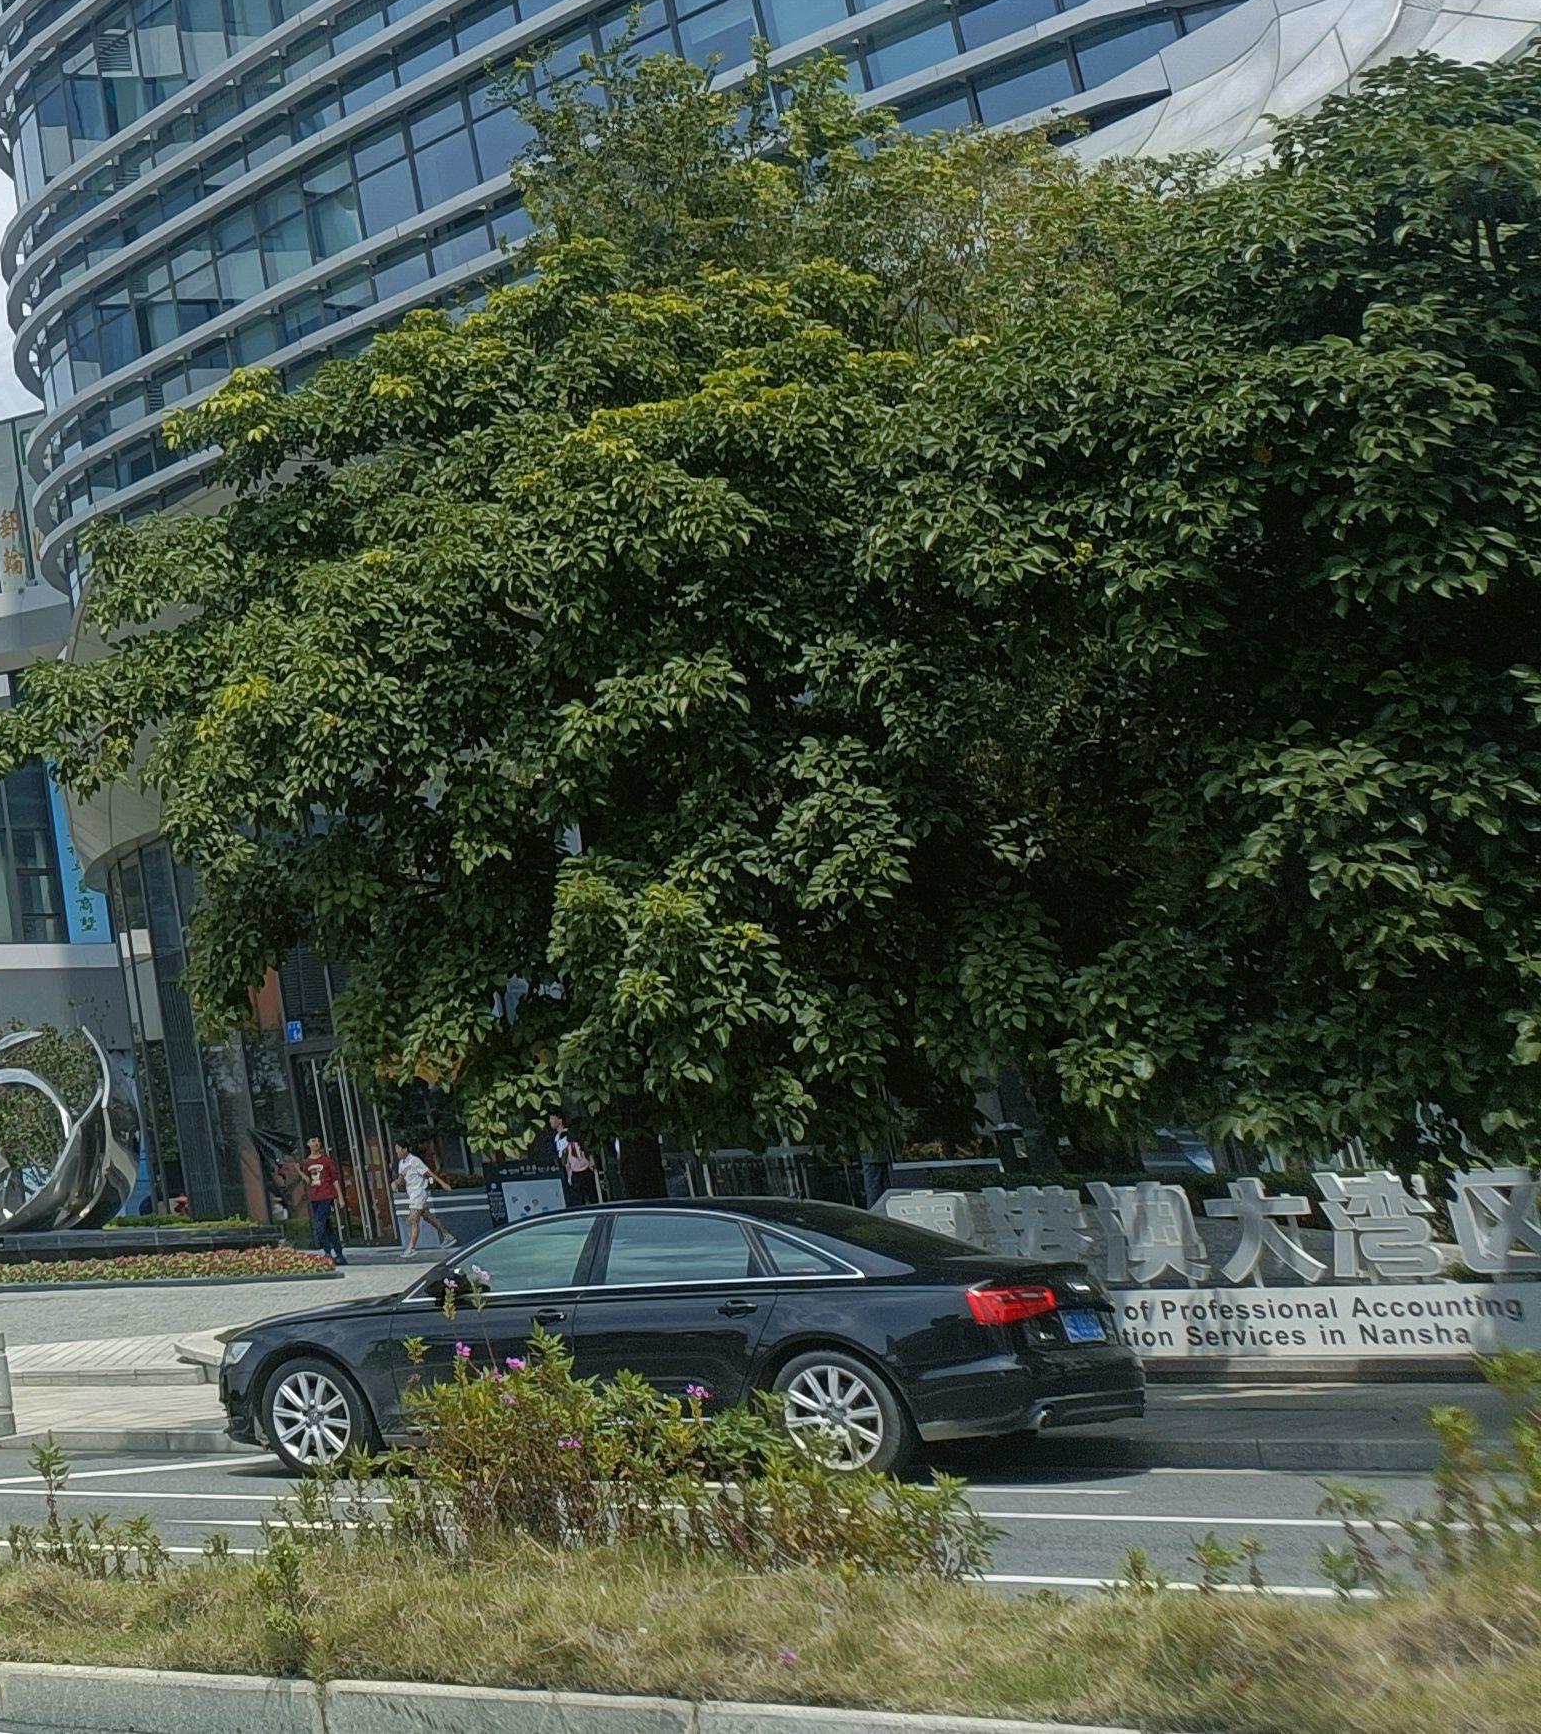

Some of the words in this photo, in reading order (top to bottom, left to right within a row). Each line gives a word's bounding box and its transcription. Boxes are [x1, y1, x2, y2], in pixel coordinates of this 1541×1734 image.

[1124, 1299, 1149, 1321] of
[1161, 1297, 1338, 1321] Professional
[1351, 1296, 1525, 1321] Accounting
[1122, 1326, 1174, 1347] tion
[1187, 1325, 1306, 1347] Services
[1319, 1324, 1346, 1345] in
[1359, 1322, 1472, 1345] Nansha
